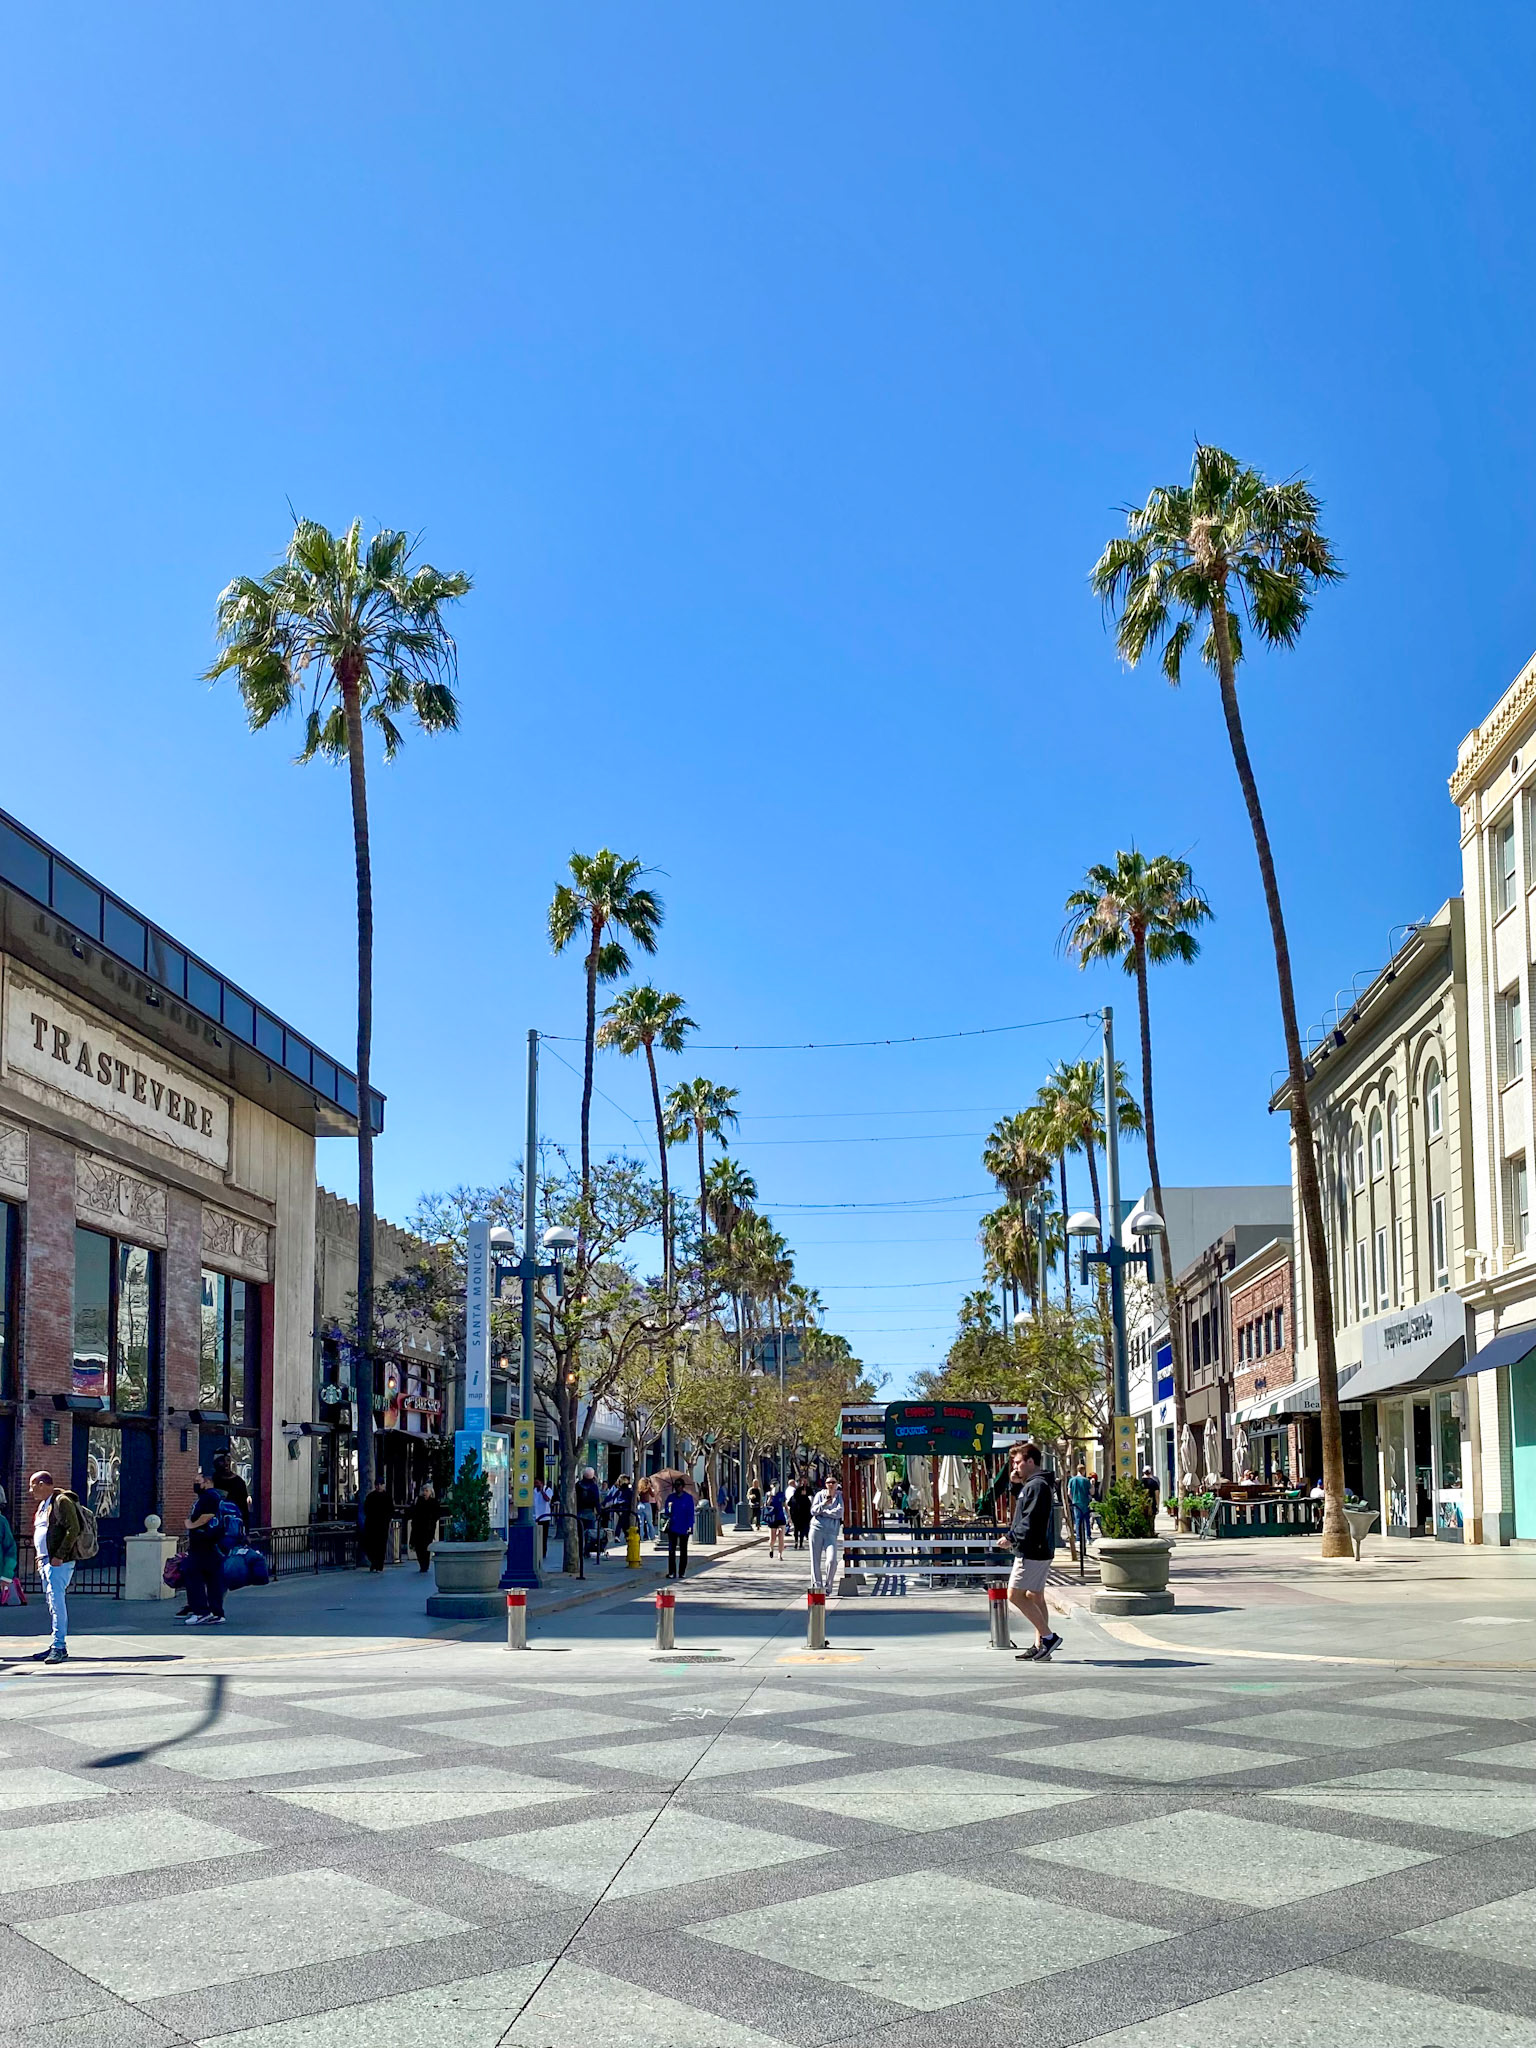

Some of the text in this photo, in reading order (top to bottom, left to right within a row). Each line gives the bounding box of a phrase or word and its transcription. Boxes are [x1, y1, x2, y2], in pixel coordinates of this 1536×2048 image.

[31, 1012, 213, 1138] TRASTEVERE
[473, 1243, 482, 1346] SANTA MONICA
[468, 1392, 483, 1400] map
